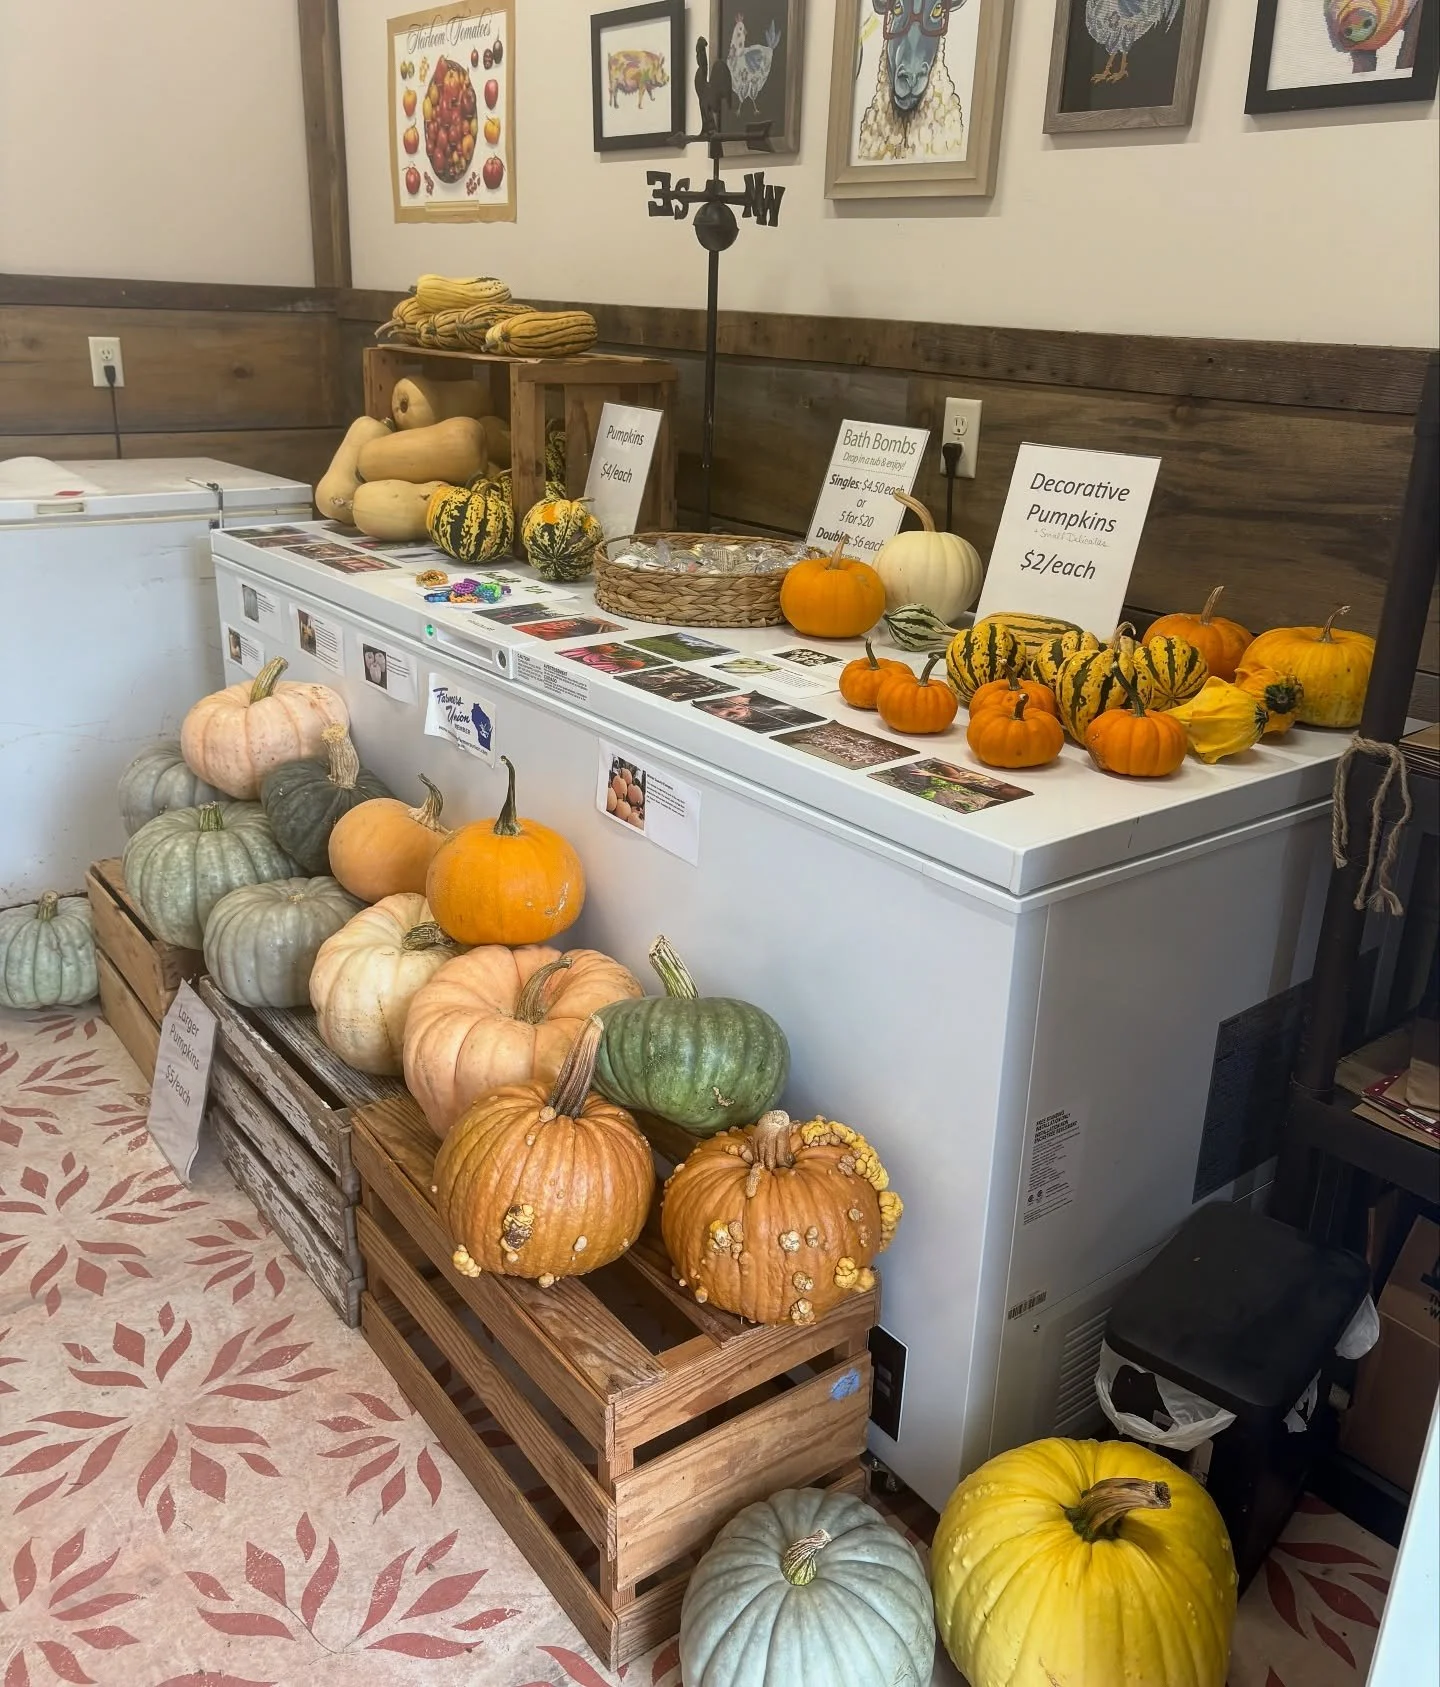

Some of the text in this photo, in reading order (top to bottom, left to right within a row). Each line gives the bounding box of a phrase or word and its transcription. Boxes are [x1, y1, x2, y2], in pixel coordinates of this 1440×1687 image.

[407, 7, 492, 54] Heirloom Tomatoes
[606, 425, 645, 446] Pumpkins
[843, 428, 918, 456] Bath Bombs
[600, 461, 633, 483] $4/each
[842, 452, 858, 464] Drop
[870, 457, 880, 467] tub
[886, 459, 907, 473] enjoy!
[829, 474, 861, 490] Singles:
[861, 479, 885, 495] $4.50
[1030, 472, 1130, 502] Decorative
[856, 498, 867, 508] or
[839, 511, 875, 528] 5 for $20
[1026, 503, 1117, 533] Pumpkins
[816, 527, 851, 545] Doubls:
[853, 534, 864, 548] $6
[1020, 549, 1096, 580] $2/each
[445, 704, 470, 724] Union
[178, 1003, 200, 1037] Larger
[170, 1023, 200, 1070] Pumpkins
[165, 1064, 191, 1107] $5/each
